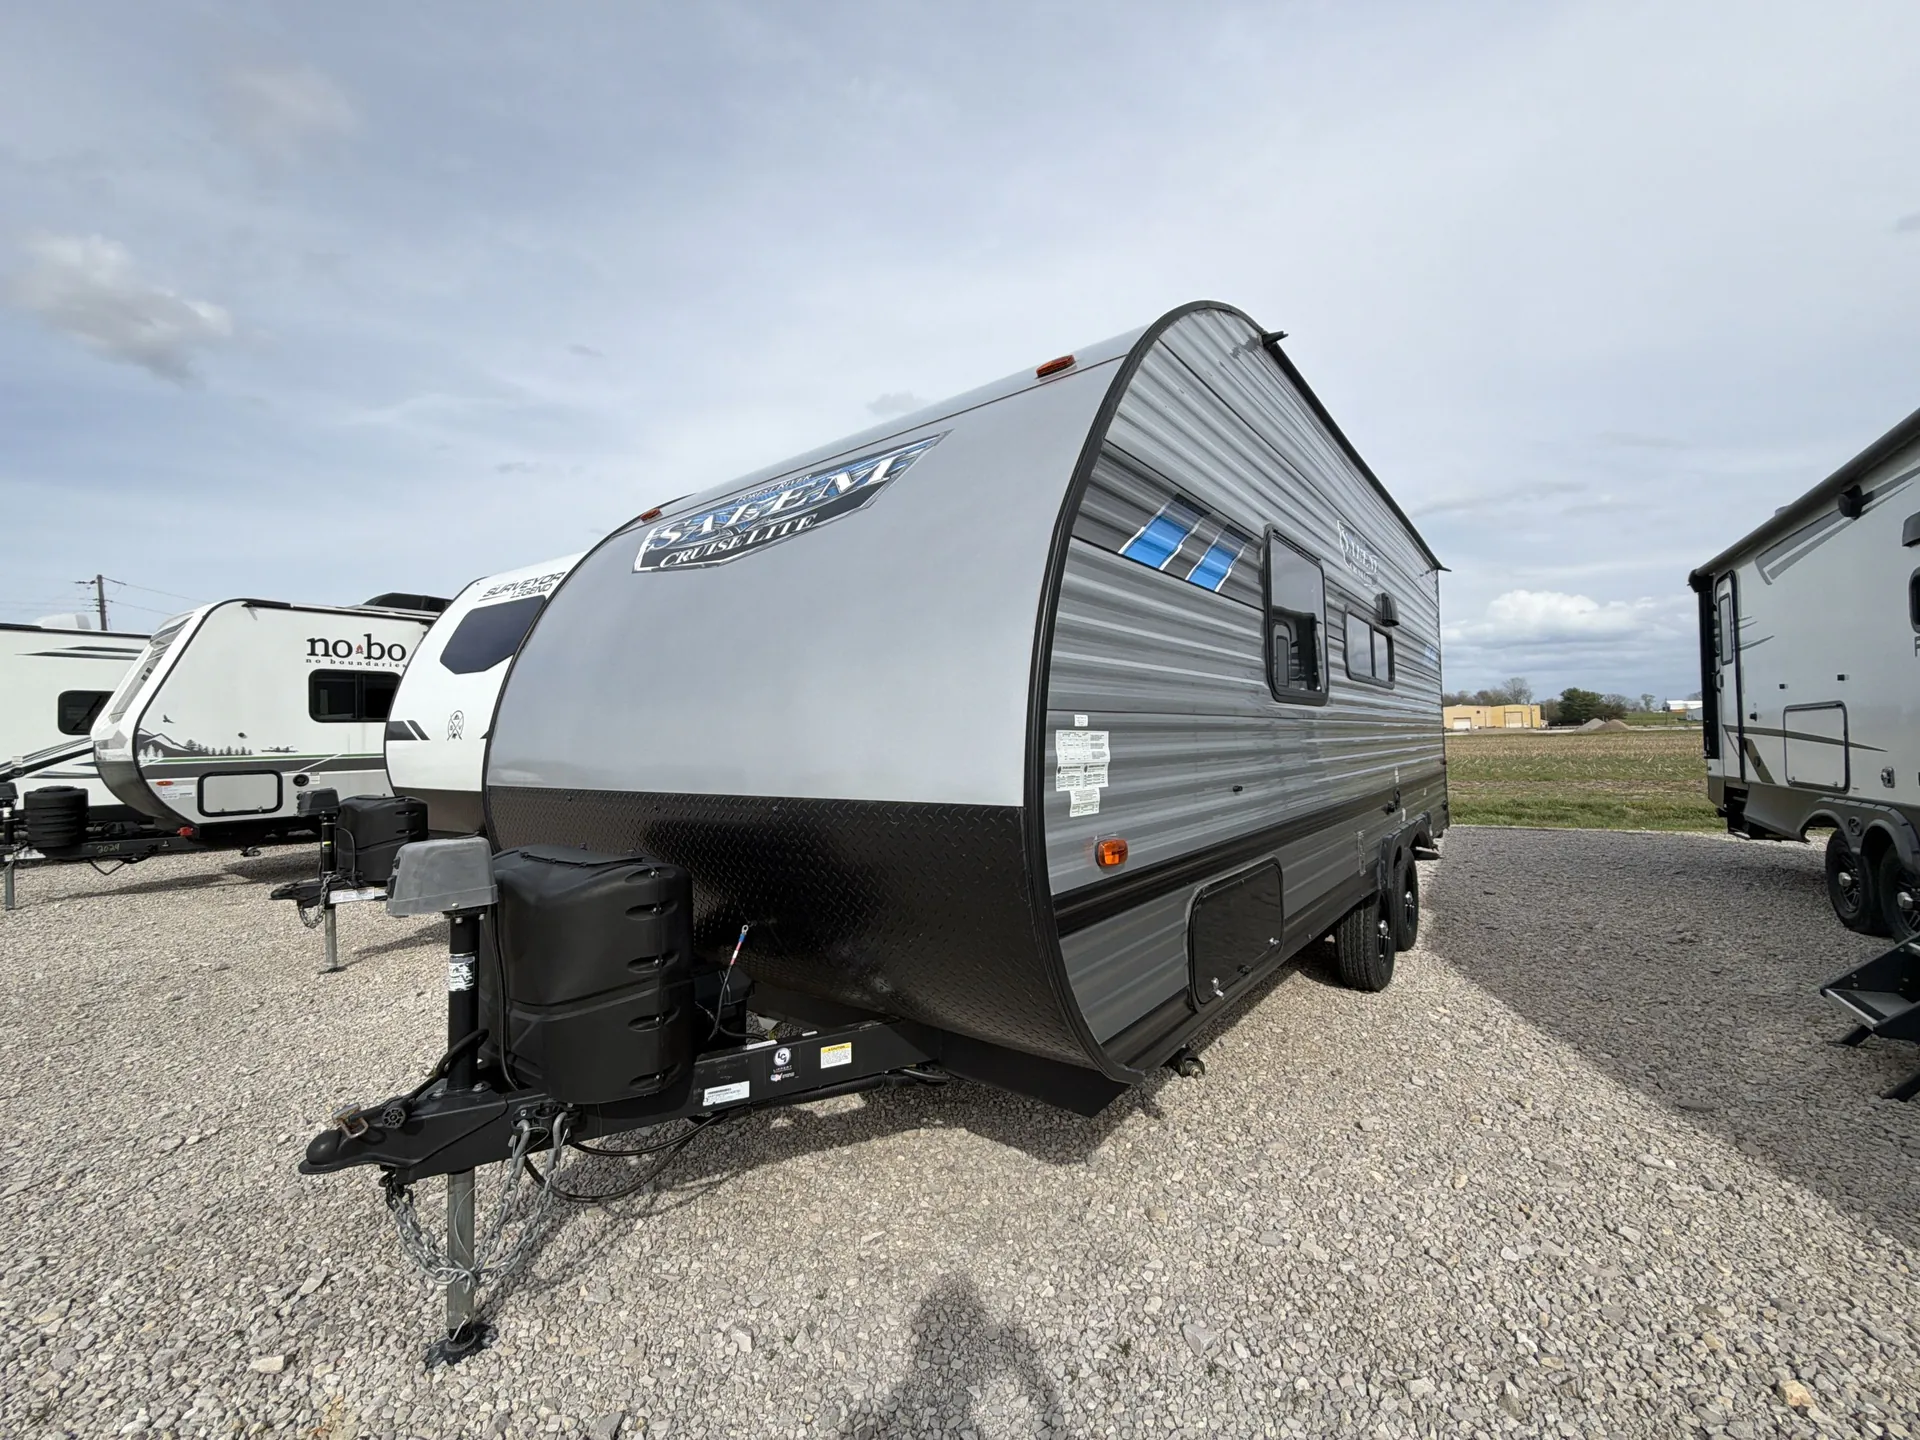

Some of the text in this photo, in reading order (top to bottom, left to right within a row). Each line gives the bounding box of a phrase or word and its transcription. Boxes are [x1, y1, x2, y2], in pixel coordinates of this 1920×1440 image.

[648, 455, 903, 549] SALEM
[659, 513, 819, 568] CRUISE LITE
[482, 571, 567, 598] SURVEYOR
[510, 583, 553, 599] LEGEND
